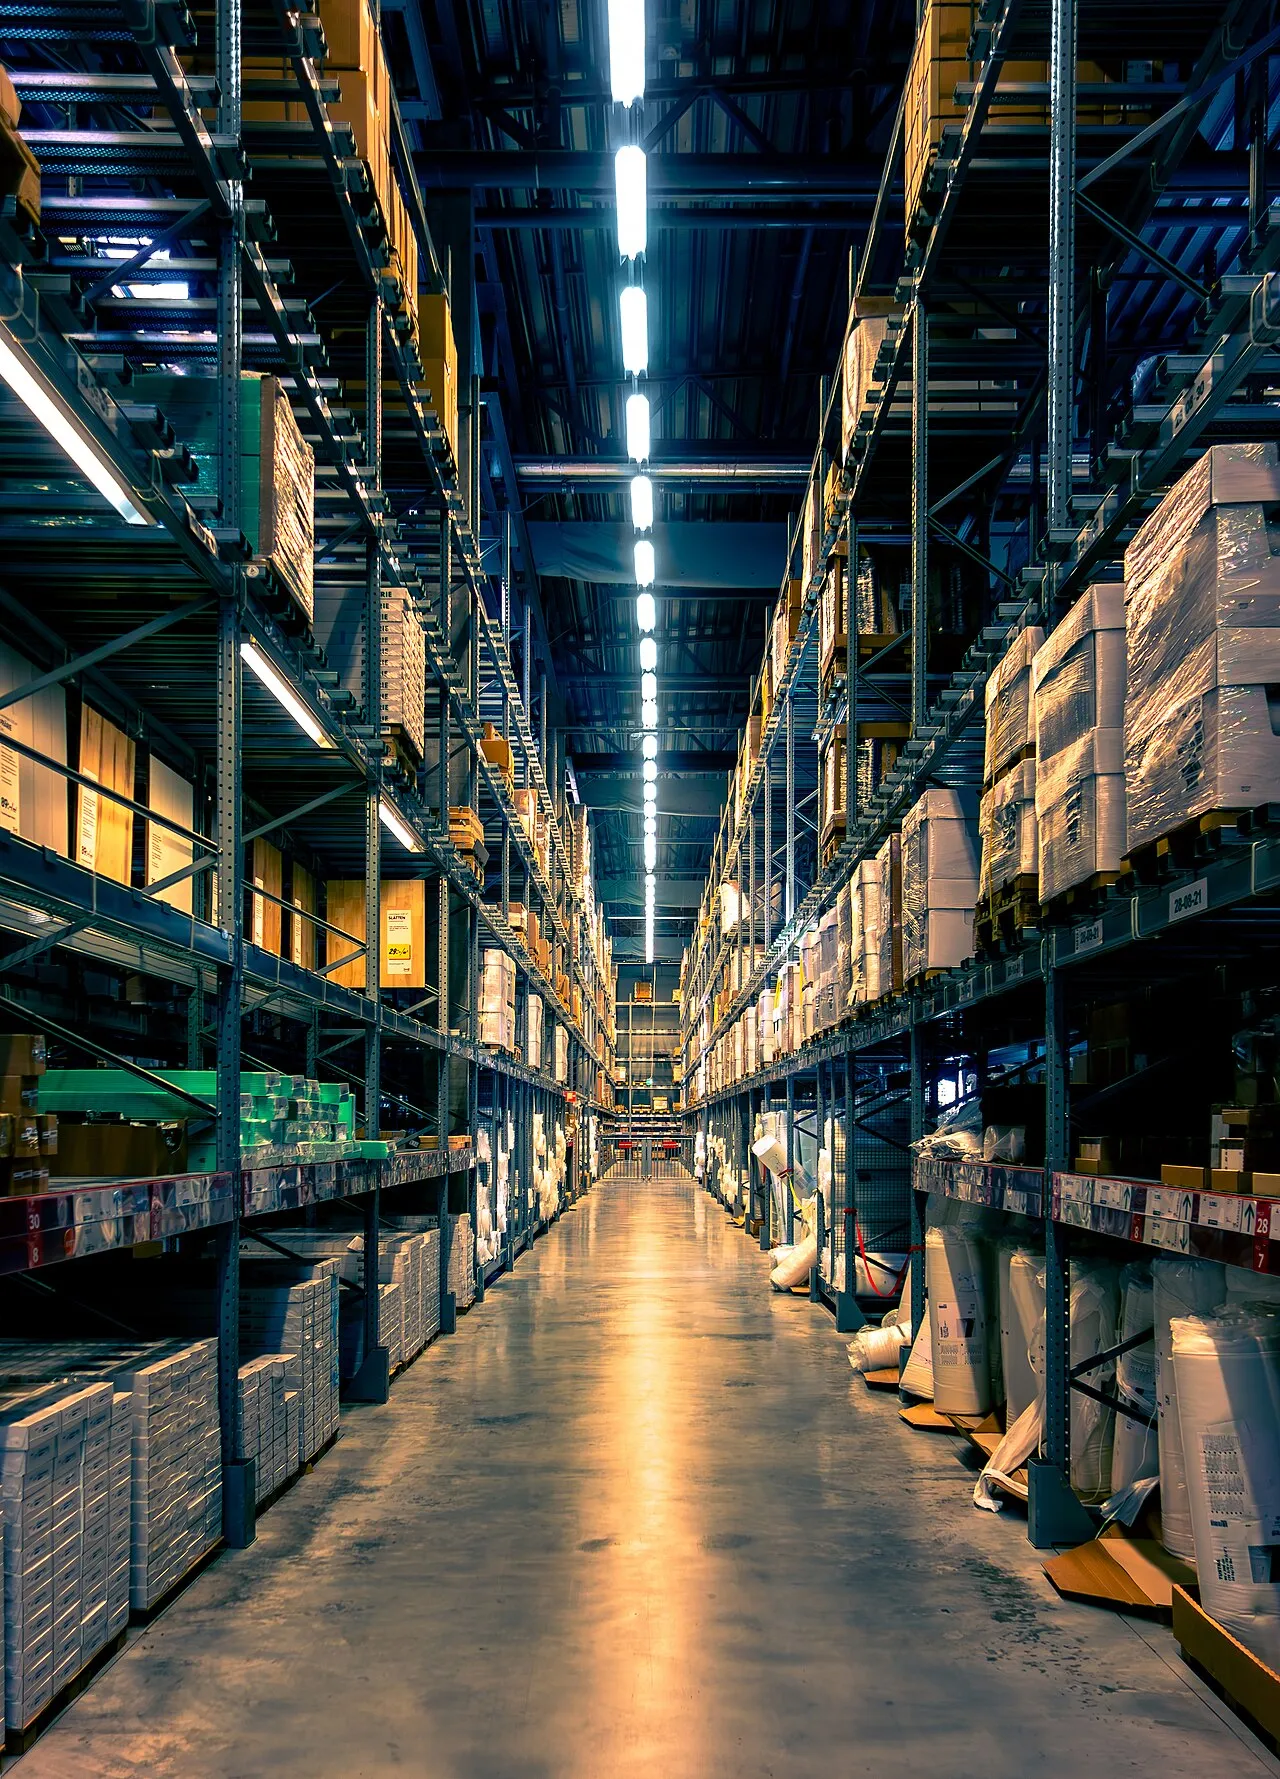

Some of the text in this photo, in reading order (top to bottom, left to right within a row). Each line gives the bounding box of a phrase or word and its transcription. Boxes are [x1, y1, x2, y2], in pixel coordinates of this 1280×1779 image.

[1174, 889, 1202, 913] 28-08-21
[29, 1214, 40, 1230] 30
[1257, 1218, 1268, 1234] 28
[1134, 1226, 1139, 1239] 8
[32, 1247, 39, 1263] 8
[1258, 1253, 1265, 1268] 7
